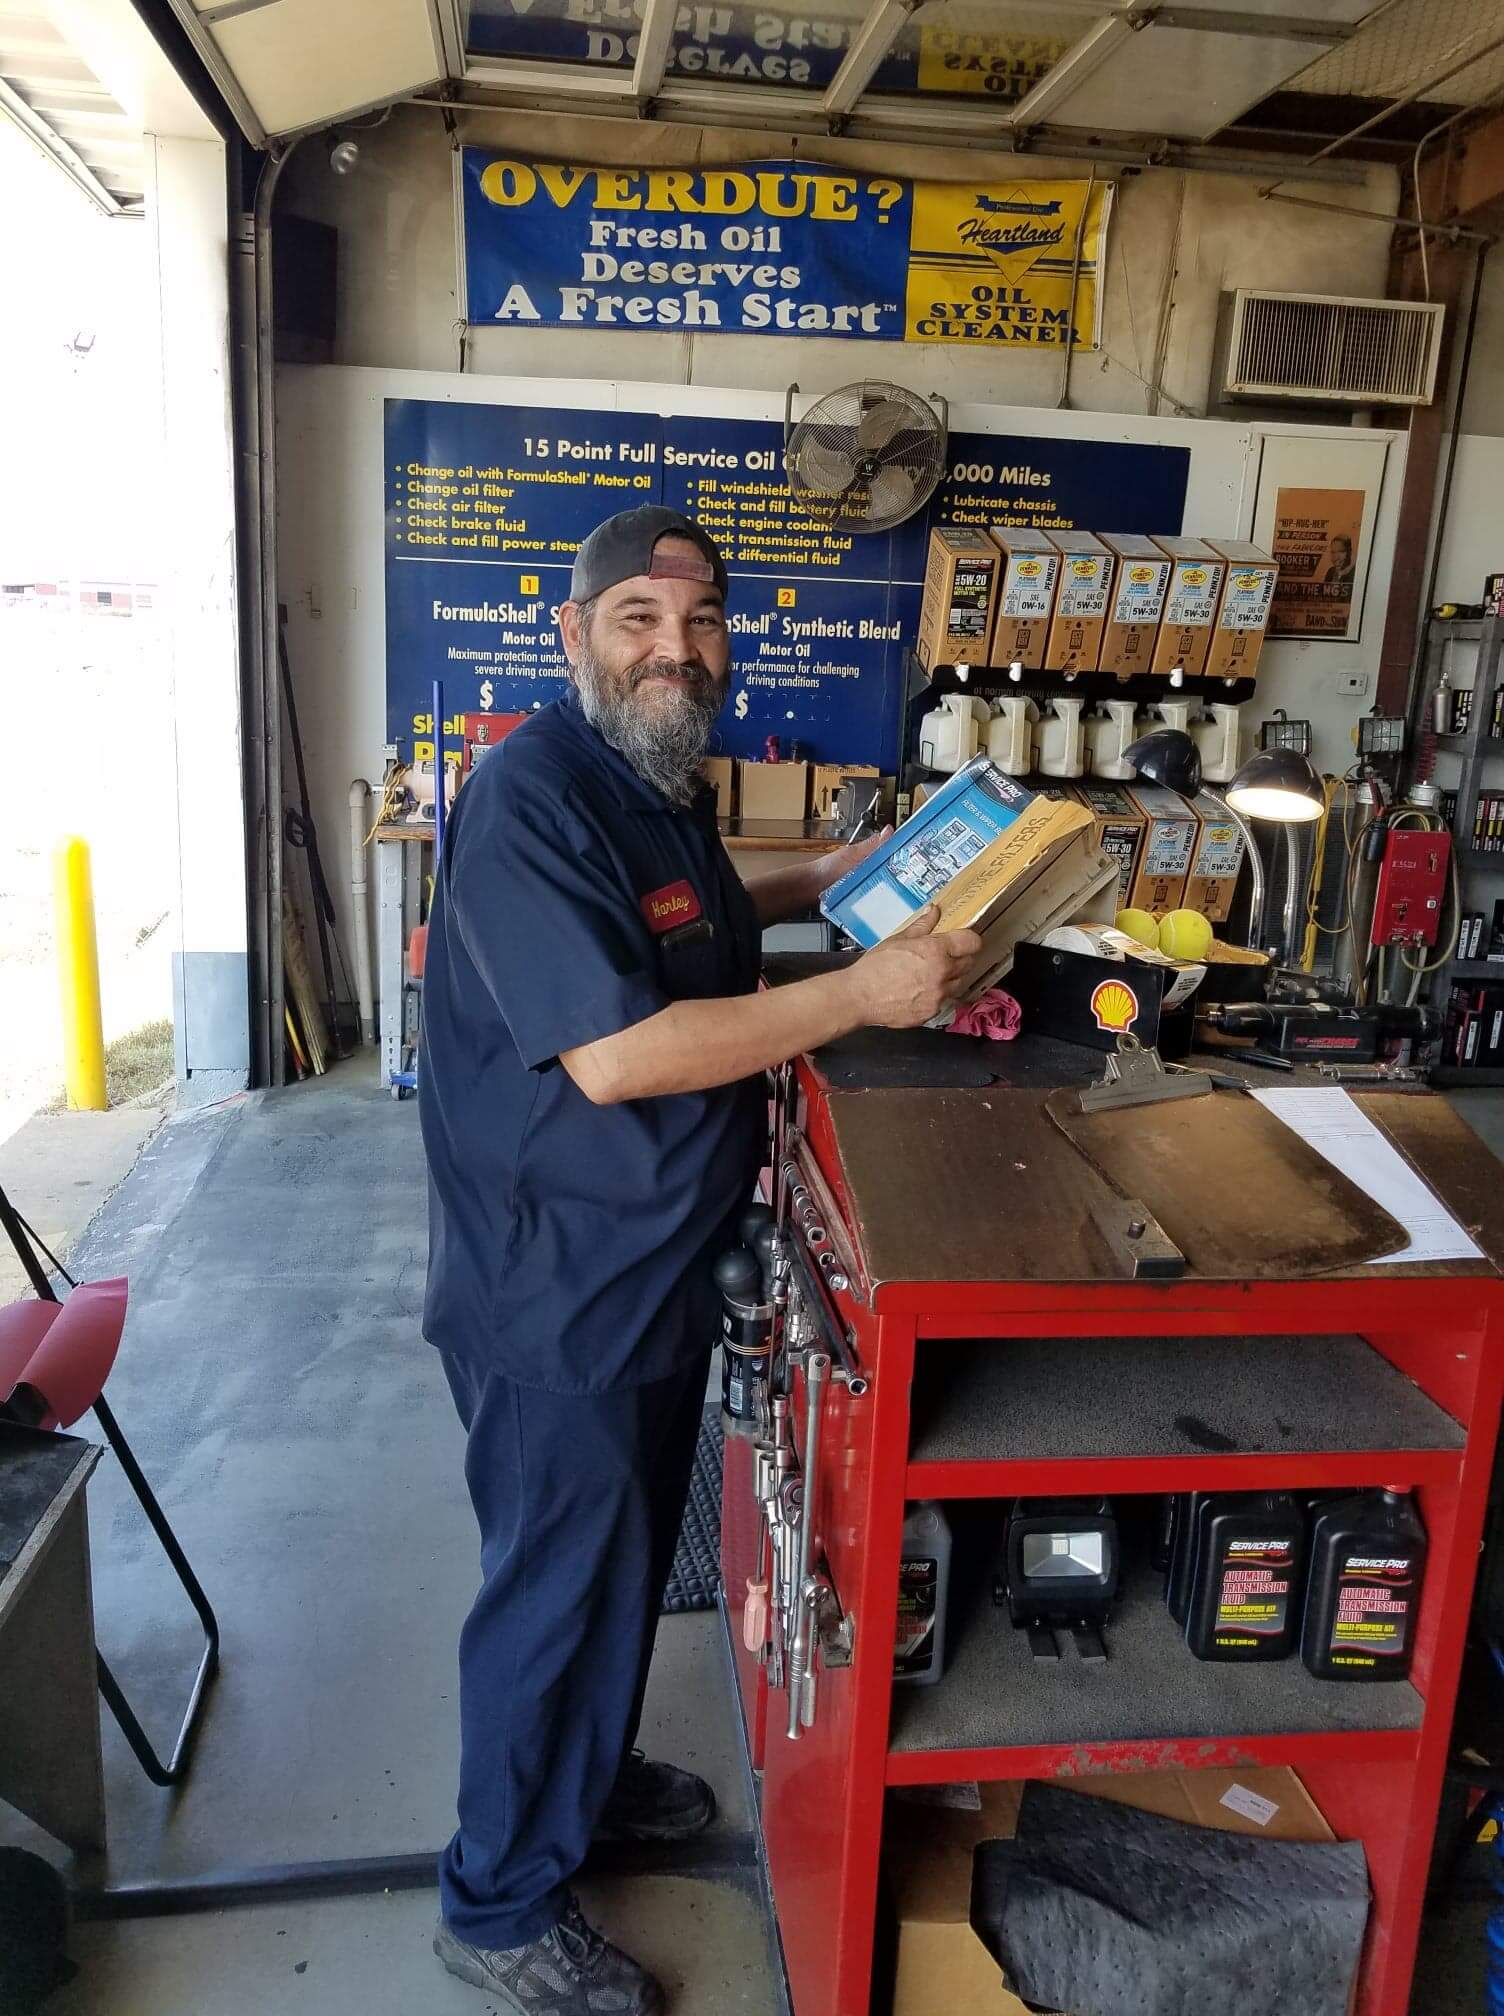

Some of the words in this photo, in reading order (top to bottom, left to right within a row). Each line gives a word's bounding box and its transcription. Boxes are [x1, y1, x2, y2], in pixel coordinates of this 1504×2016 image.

[481, 160, 903, 224] OVERDUE?
[589, 221, 707, 251] Fresh
[721, 226, 781, 253] Oil
[957, 219, 1066, 245] Heartland
[581, 252, 801, 289] Deserves
[971, 285, 1032, 304] OIL
[495, 284, 541, 320] A
[559, 287, 722, 326] Fresh
[930, 302, 1070, 324] SYSTEM
[916, 319, 1082, 343] CLEANER
[524, 438, 549, 458] 15
[557, 440, 612, 461] Point
[619, 444, 655, 463] Full
[664, 446, 738, 469] Service
[745, 451, 775, 471] Oil
[407, 463, 455, 481] Change
[458, 466, 473, 479] oil
[477, 467, 504, 481] with
[593, 473, 630, 487] Motor
[633, 475, 651, 488] Oil
[946, 463, 994, 484] ,000
[999, 466, 1051, 487] Miles
[407, 481, 458, 497] Change
[463, 483, 479, 496] oil
[483, 484, 514, 498] filter
[698, 480, 717, 493] Fill
[721, 482, 791, 497] windshield
[407, 498, 447, 512] Check
[451, 500, 470, 512] air
[475, 501, 506, 515] filter
[697, 497, 736, 510] Check
[740, 499, 766, 512] and
[769, 499, 786, 513] fill
[954, 494, 1009, 509] Lubricate
[1013, 498, 1056, 512] chassis
[407, 515, 447, 529] Check
[451, 517, 491, 531] brake
[496, 518, 526, 532] fluid
[696, 514, 735, 528] Check
[739, 516, 783, 531] engine
[952, 511, 988, 525] Check
[992, 514, 1028, 528] wiper
[1032, 515, 1073, 529] blades
[407, 532, 447, 546] Check
[451, 534, 478, 547] and
[482, 535, 499, 548] fill
[503, 537, 544, 551] power
[550, 539, 583, 552] steer
[705, 530, 735, 544] eck
[738, 533, 819, 549] transmission
[823, 536, 852, 550] fluid
[738, 549, 808, 564] differential
[812, 552, 840, 566] fluid
[525, 578, 532, 592] 1
[961, 574, 987, 586] 5W-20
[781, 591, 791, 605] 2
[1301, 584, 1320, 596] THE
[1021, 602, 1045, 610] 0W-16
[1132, 608, 1158, 616] 5W-30
[1184, 610, 1210, 618] 5W-30
[1237, 614, 1263, 622] 5W-30
[782, 617, 854, 641] Synthetic
[859, 620, 901, 641] Blend
[503, 632, 536, 646] Motor
[540, 632, 555, 647] Oil
[448, 646, 492, 662] Maximum
[495, 649, 537, 664] protection
[541, 651, 566, 664] under
[760, 642, 792, 656] Motor
[795, 644, 811, 657] Oil
[475, 664, 503, 676] severe
[506, 664, 536, 679] driving
[539, 666, 572, 678] conditi
[742, 659, 795, 673] performance
[798, 660, 810, 673] for
[812, 661, 860, 678] challenging
[746, 672, 775, 689] driving
[778, 676, 820, 688] conditions
[480, 680, 494, 711] $
[735, 689, 749, 720] $
[979, 760, 1010, 788] SERVICE
[1003, 784, 1023, 798] PRO
[1106, 843, 1132, 853] 5W-30
[1160, 861, 1184, 869] 5W-30
[651, 896, 690, 919] Harley
[1229, 1541, 1267, 1550] SERVICE
[1267, 1540, 1290, 1550] PRO
[908, 1562, 931, 1572] PRO
[1346, 1558, 1387, 1568] SERVICE
[1386, 1559, 1409, 1569] PRO
[1224, 1570, 1273, 1582] AUTOMATIC
[1223, 1581, 1288, 1593] TRANSMISSION
[1340, 1587, 1391, 1600] AUTOMATIC
[1221, 1593, 1246, 1605] FLUID
[1339, 1600, 1407, 1613] TRANSMISSION
[1338, 1611, 1362, 1623] FLUID
